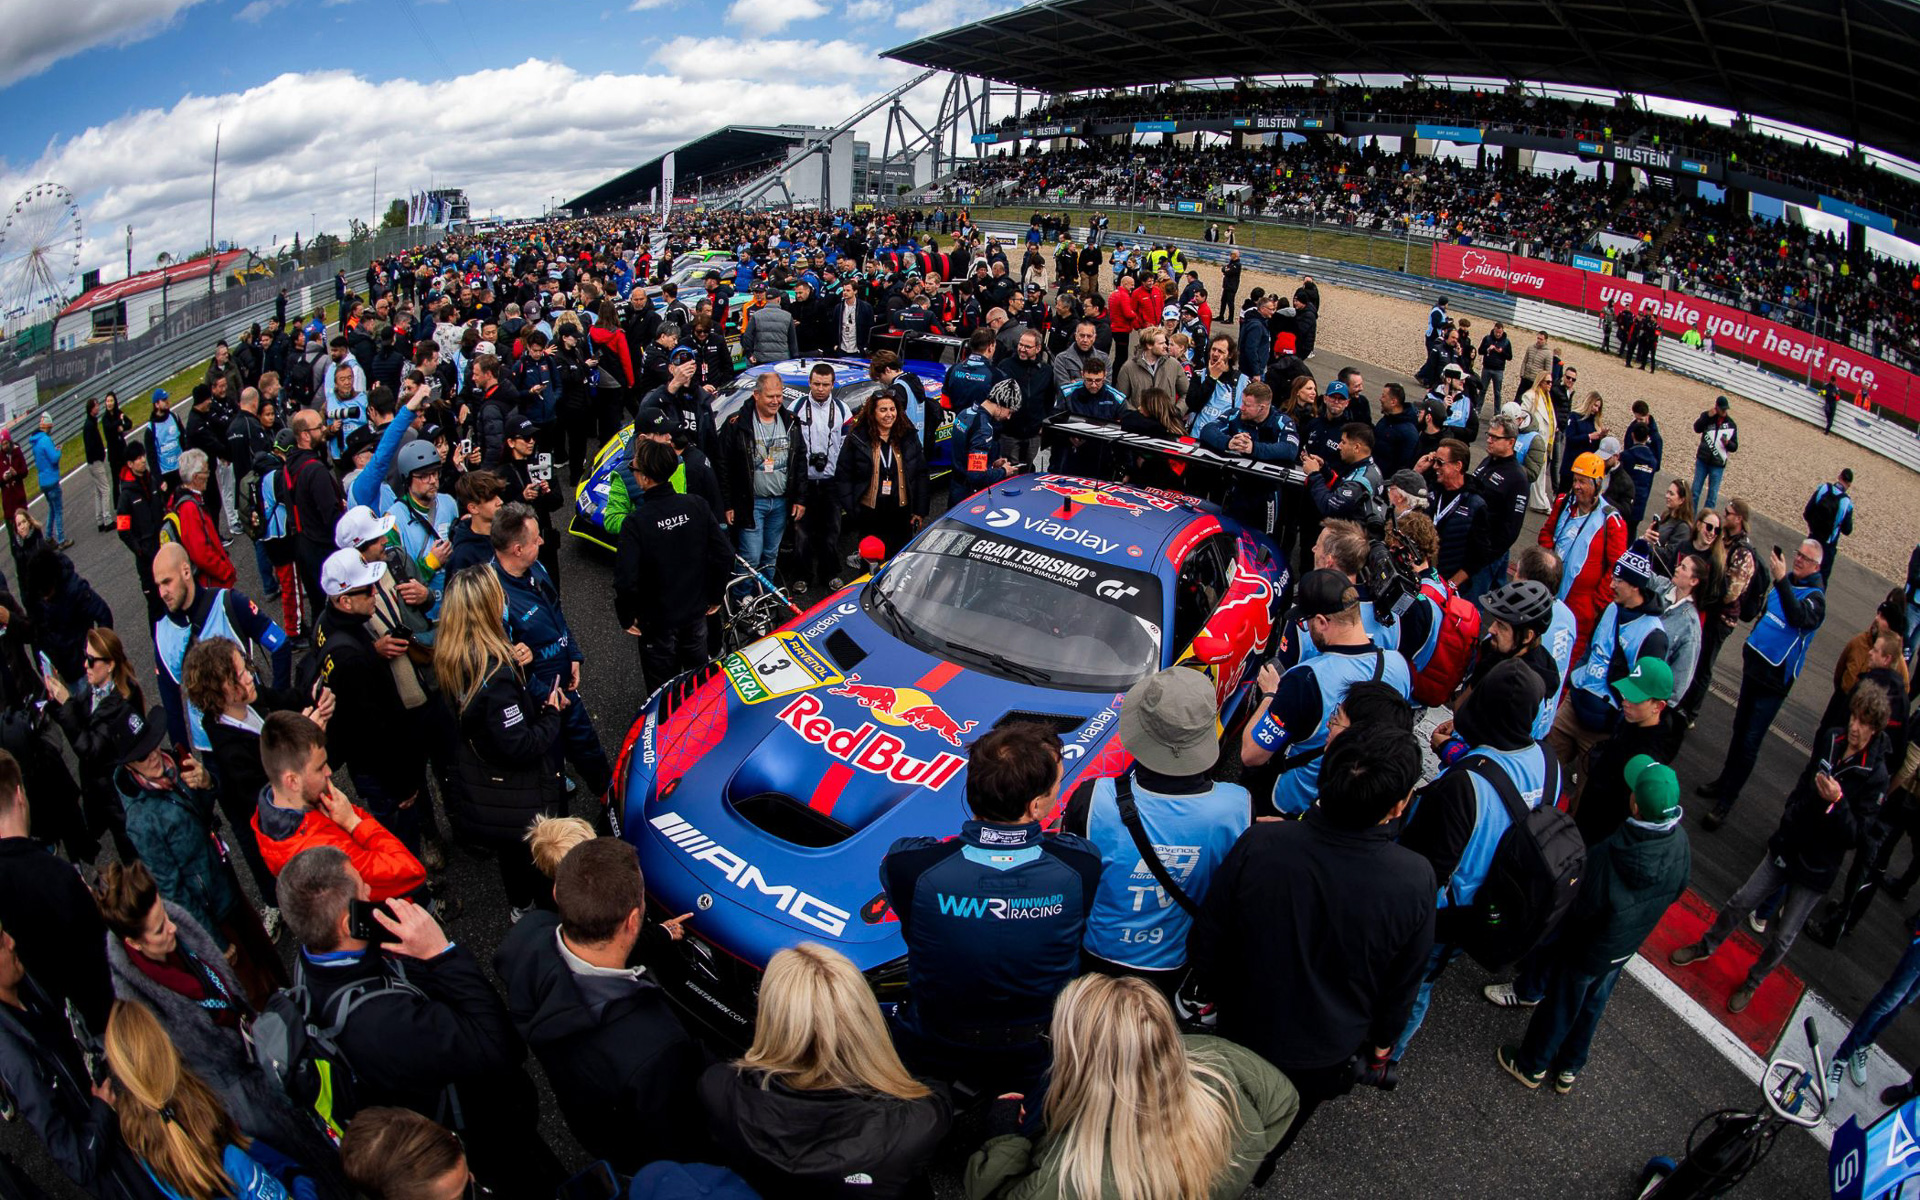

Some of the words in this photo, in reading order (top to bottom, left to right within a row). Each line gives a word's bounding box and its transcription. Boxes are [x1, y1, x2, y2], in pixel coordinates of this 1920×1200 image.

[1036, 126, 1060, 136] BILSTEIN
[1257, 118, 1297, 129] BILSTEIN
[1614, 146, 1671, 168] BILSTEIN
[1474, 264, 1545, 289] nürburgring
[1600, 286, 1634, 307] we
[1638, 296, 1701, 327] make
[1706, 313, 1760, 344] your
[1762, 328, 1826, 369] heart
[1828, 356, 1879, 391] race.
[657, 513, 691, 529] NOVEL
[1023, 516, 1120, 555] viaplay
[970, 538, 1014, 559] GRAN
[968, 552, 982, 560] THE
[981, 553, 1001, 565] REAL
[1001, 559, 1033, 574] DRIVING
[1033, 568, 1079, 588] SIMULATOR
[801, 612, 846, 641] viaplay
[757, 658, 792, 676] 3
[788, 640, 832, 679] RAVENOL
[728, 654, 762, 700] DEKRA
[1075, 706, 1117, 744] viaplay
[1258, 728, 1275, 745] 26
[1264, 715, 1286, 738] WTCR
[693, 841, 851, 937] AMG
[1011, 893, 1064, 909] WINWARD
[1127, 885, 1176, 912] TV
[1011, 903, 1063, 920] RACING
[1119, 927, 1164, 945] 169
[685, 980, 749, 1025] VERSTAPPEN.COM
